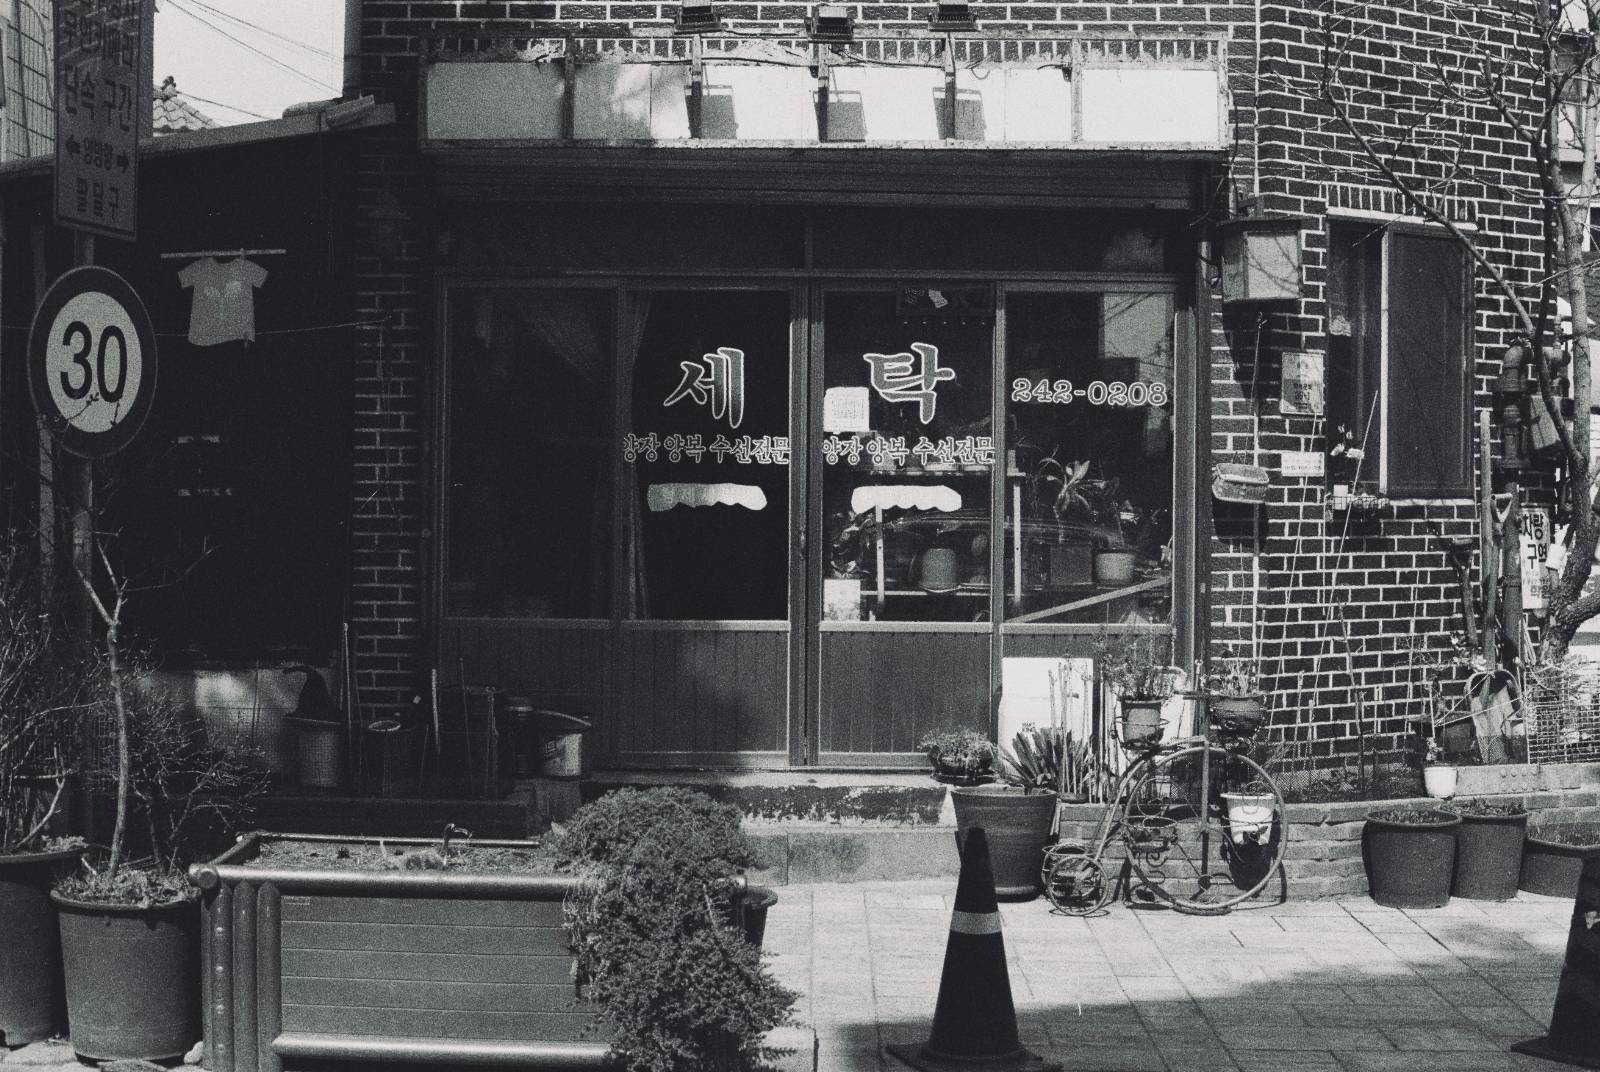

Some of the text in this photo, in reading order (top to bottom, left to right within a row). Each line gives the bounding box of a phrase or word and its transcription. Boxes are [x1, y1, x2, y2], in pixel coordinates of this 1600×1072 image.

[64, 66, 132, 132] 단속구간
[60, 321, 127, 402] 30
[1011, 377, 1168, 406] 242-0208
[623, 433, 791, 465] 양장 양복 수선전문
[822, 435, 995, 466] 양장 양복 수선전문
